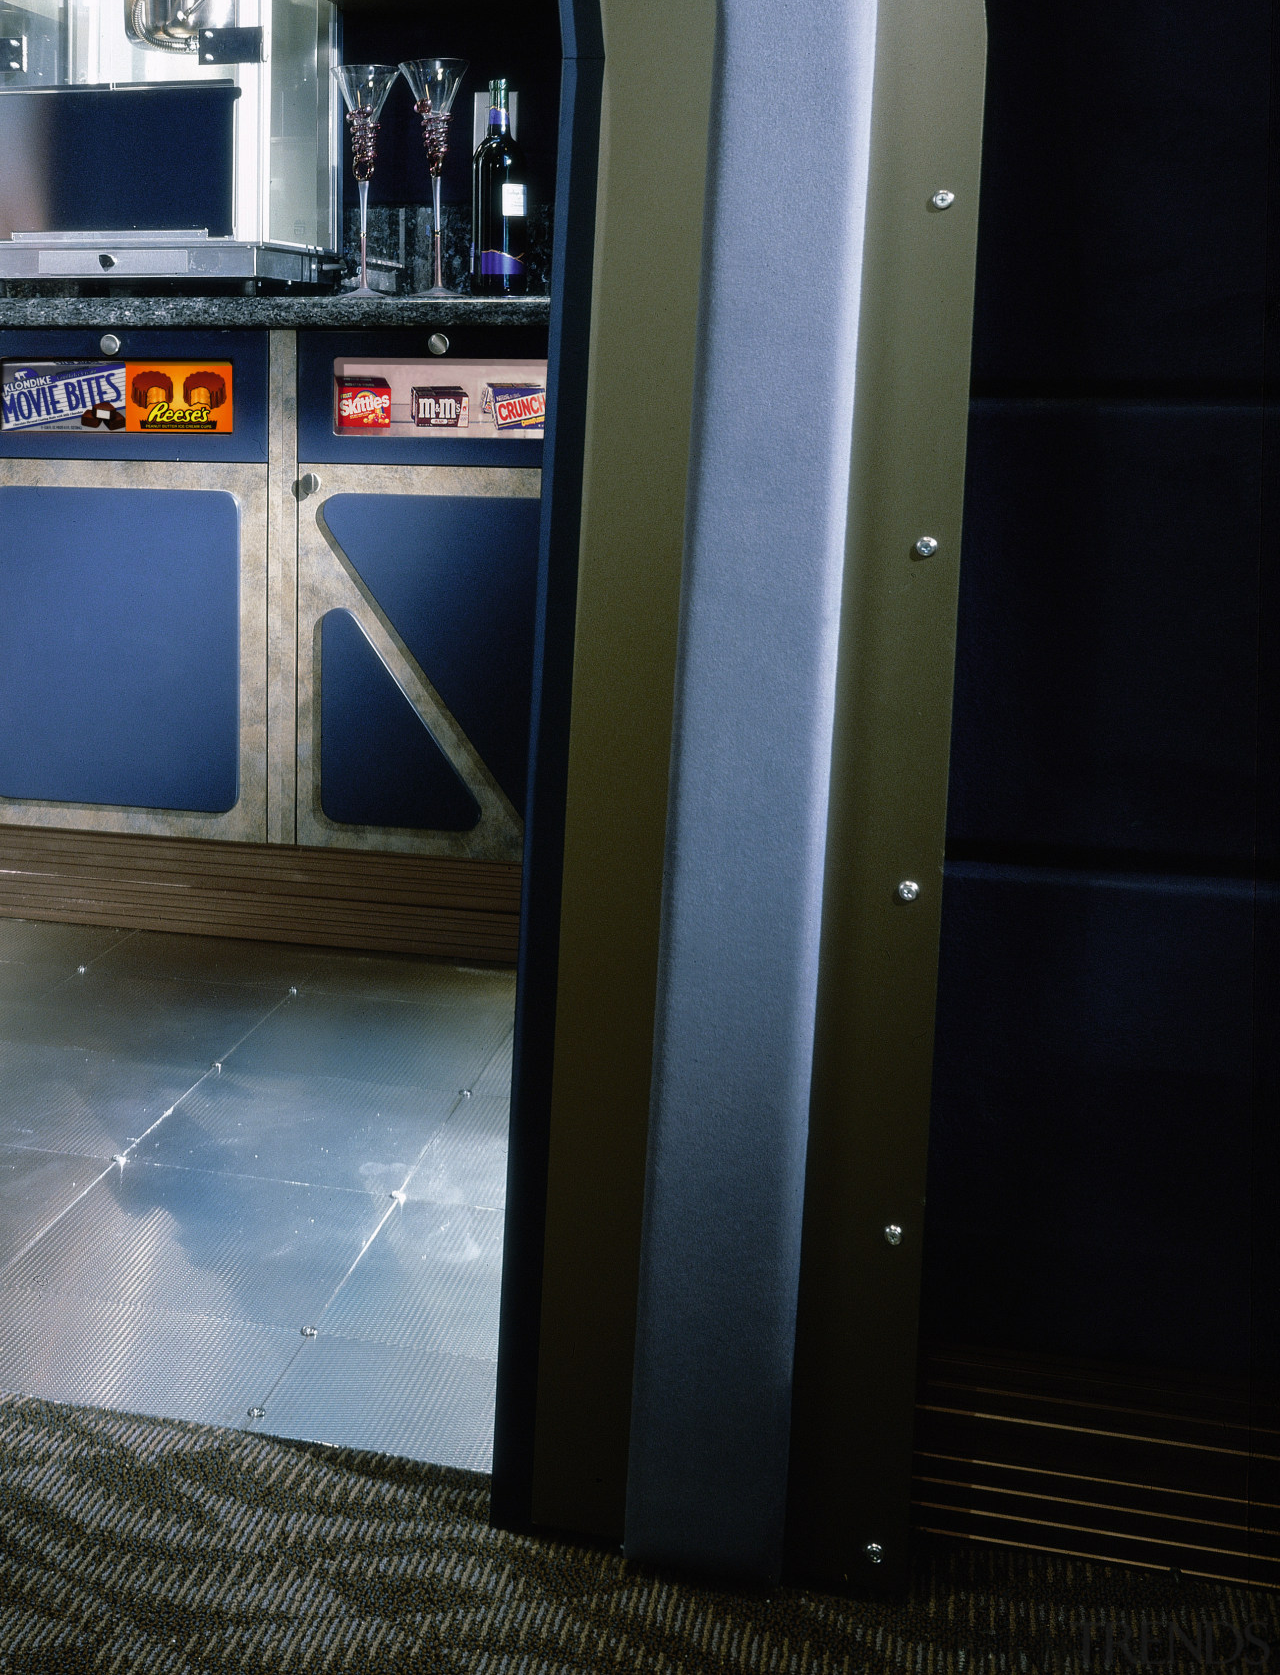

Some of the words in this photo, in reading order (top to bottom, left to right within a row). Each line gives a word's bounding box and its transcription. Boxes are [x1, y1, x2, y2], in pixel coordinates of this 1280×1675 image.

[3, 375, 54, 396] KLONDIKE
[1, 384, 64, 424] MOVIE
[63, 372, 122, 412] BITES
[339, 394, 390, 417] Skittles
[497, 393, 545, 422] CRUNCH
[148, 401, 210, 423] Reese's
